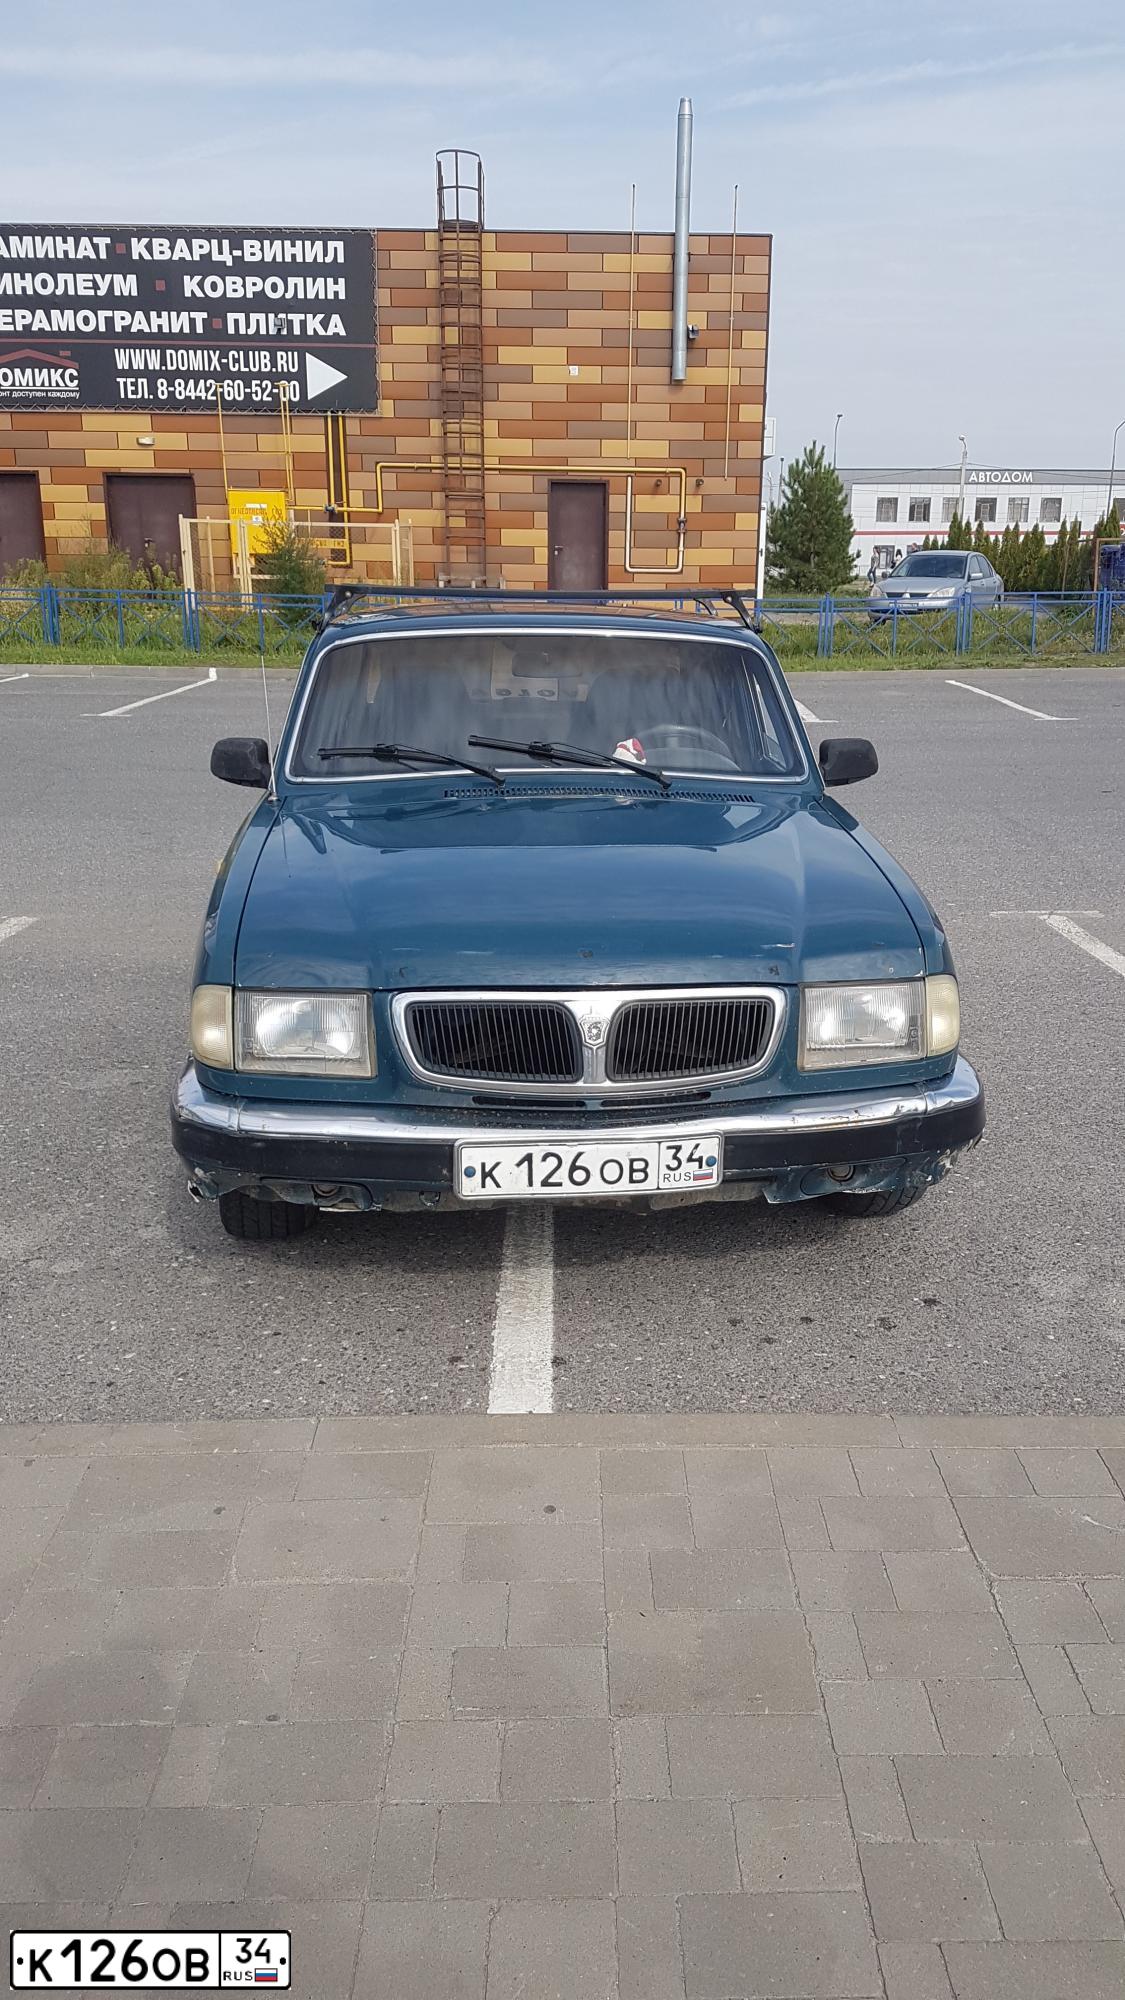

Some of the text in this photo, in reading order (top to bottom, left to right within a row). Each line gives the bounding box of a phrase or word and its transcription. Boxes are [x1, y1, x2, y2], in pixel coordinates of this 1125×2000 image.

[131, 237, 345, 266] КВАРЦ-ВИНИЛ
[184, 275, 346, 299] КОВРОЛИН
[114, 348, 299, 373] WWW.DOMIX-CLUB.RU
[12, 391, 46, 399] доступен
[48, 391, 80, 399] каждому
[116, 377, 154, 400] ТЕЛ.
[969, 471, 1032, 482] АВТОДОМ
[662, 1171, 692, 1183] RUS
